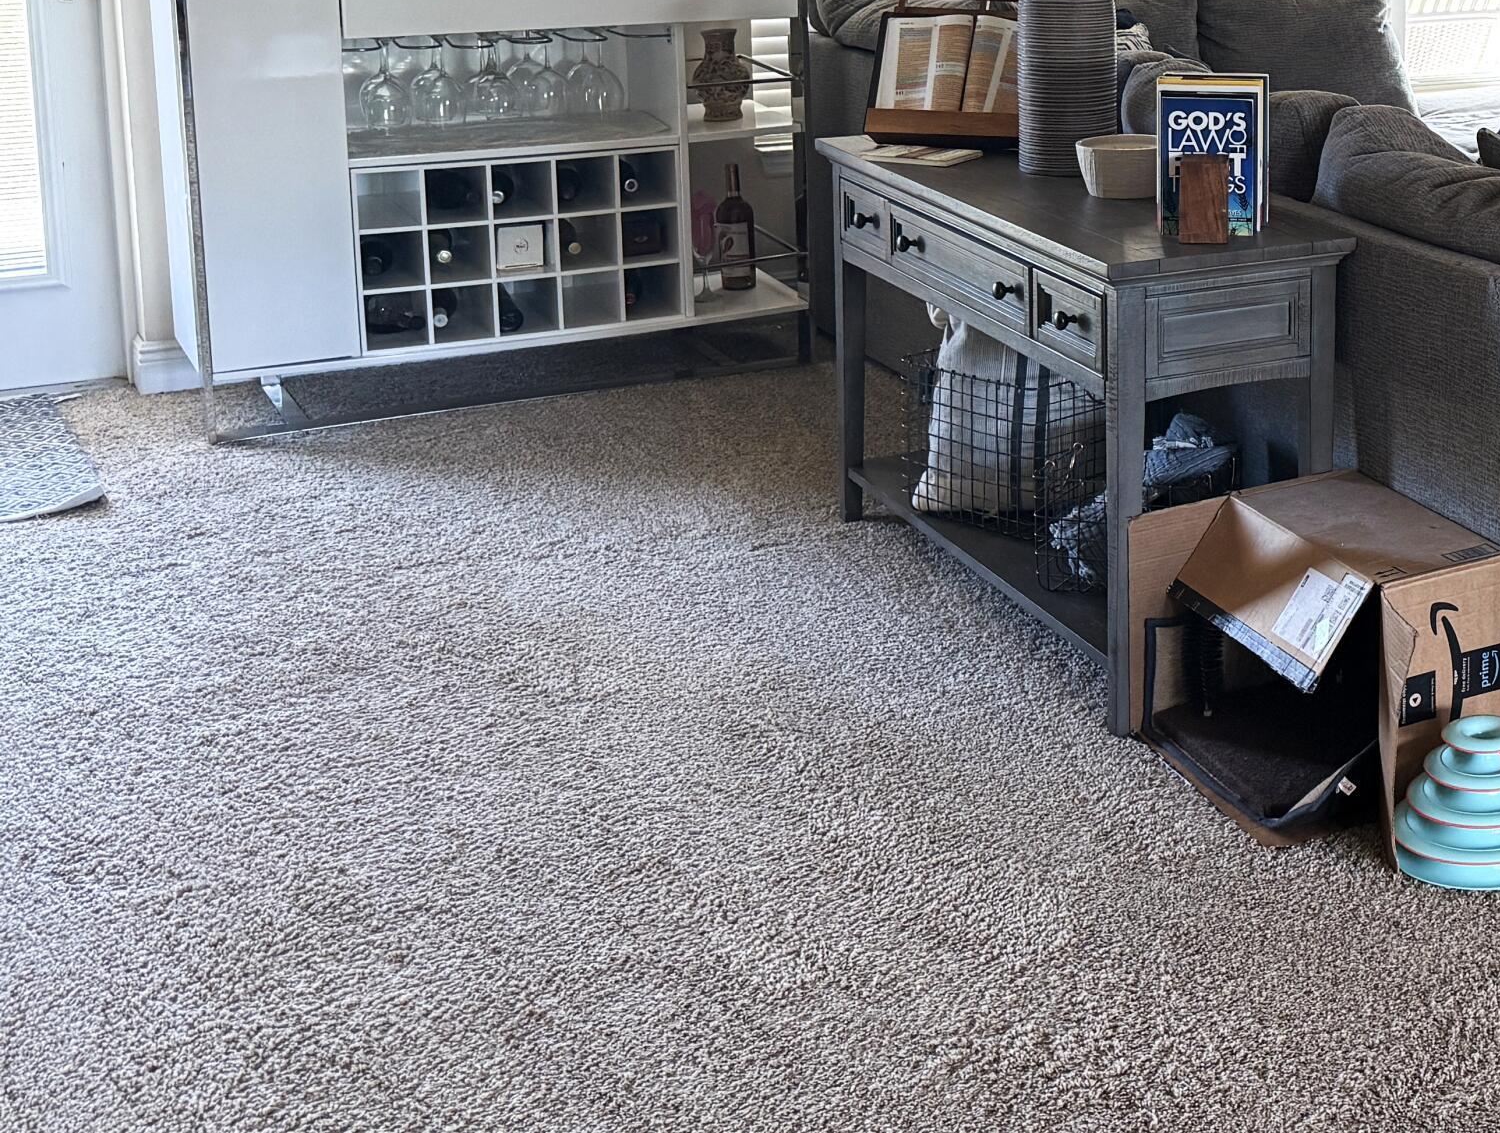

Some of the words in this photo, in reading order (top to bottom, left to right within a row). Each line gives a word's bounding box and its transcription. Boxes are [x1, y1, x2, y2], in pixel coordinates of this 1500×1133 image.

[1168, 111, 1247, 131] GOD'S
[1168, 127, 1230, 152] LAW
[1228, 128, 1247, 153] OF
[1480, 651, 1491, 689] prime
